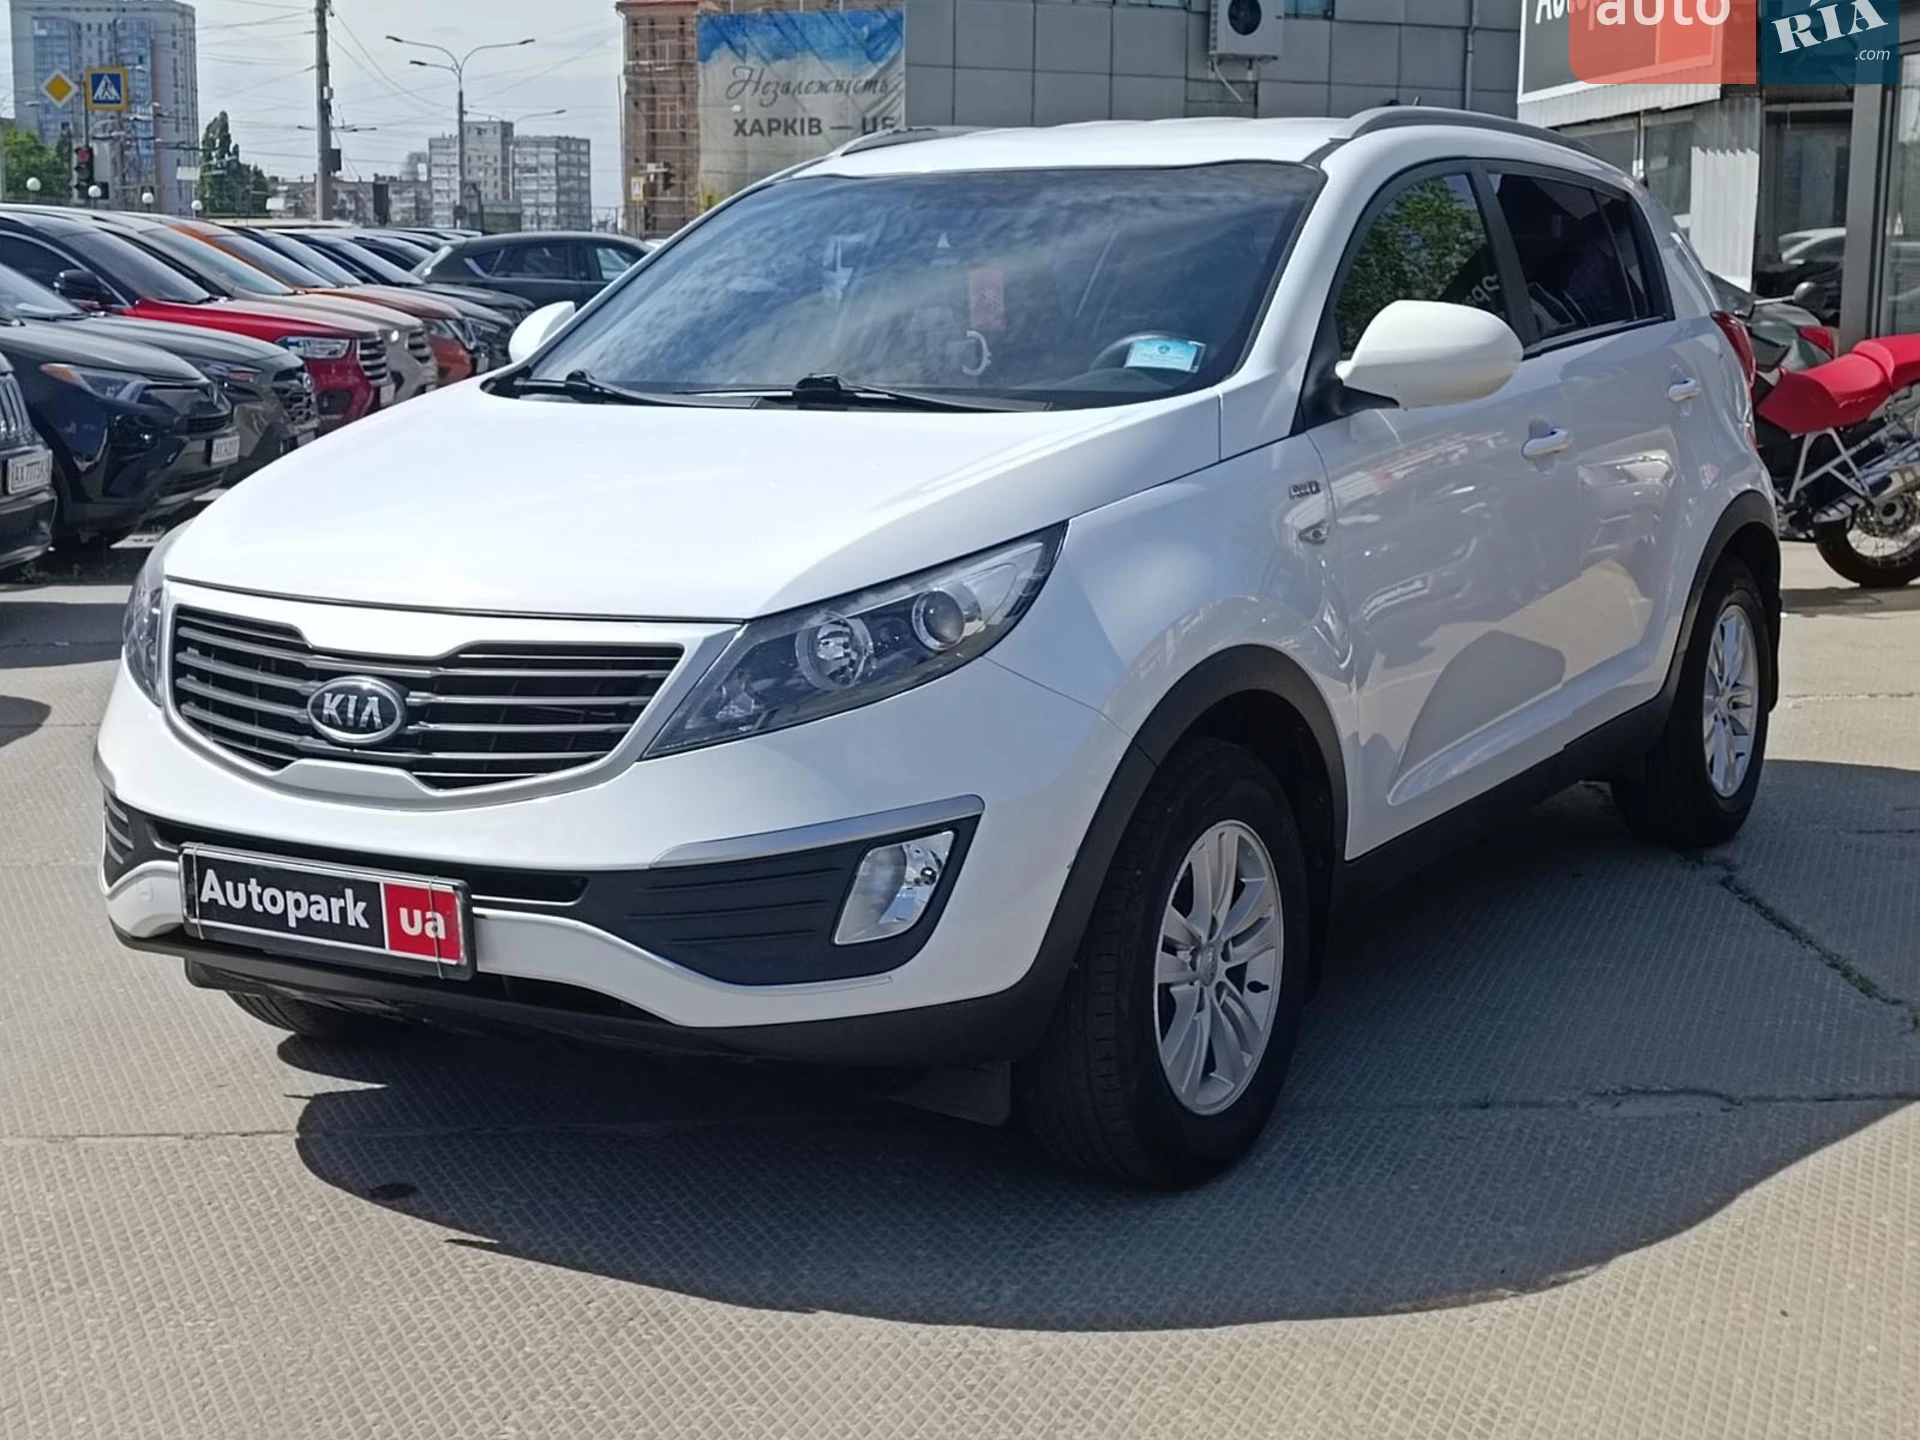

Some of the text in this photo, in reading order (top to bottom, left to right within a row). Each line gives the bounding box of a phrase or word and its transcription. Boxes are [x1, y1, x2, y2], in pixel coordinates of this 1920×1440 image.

[733, 117, 823, 138] ХАРКІВ
[322, 692, 383, 729] KIA
[200, 868, 447, 940] Autopark ua
